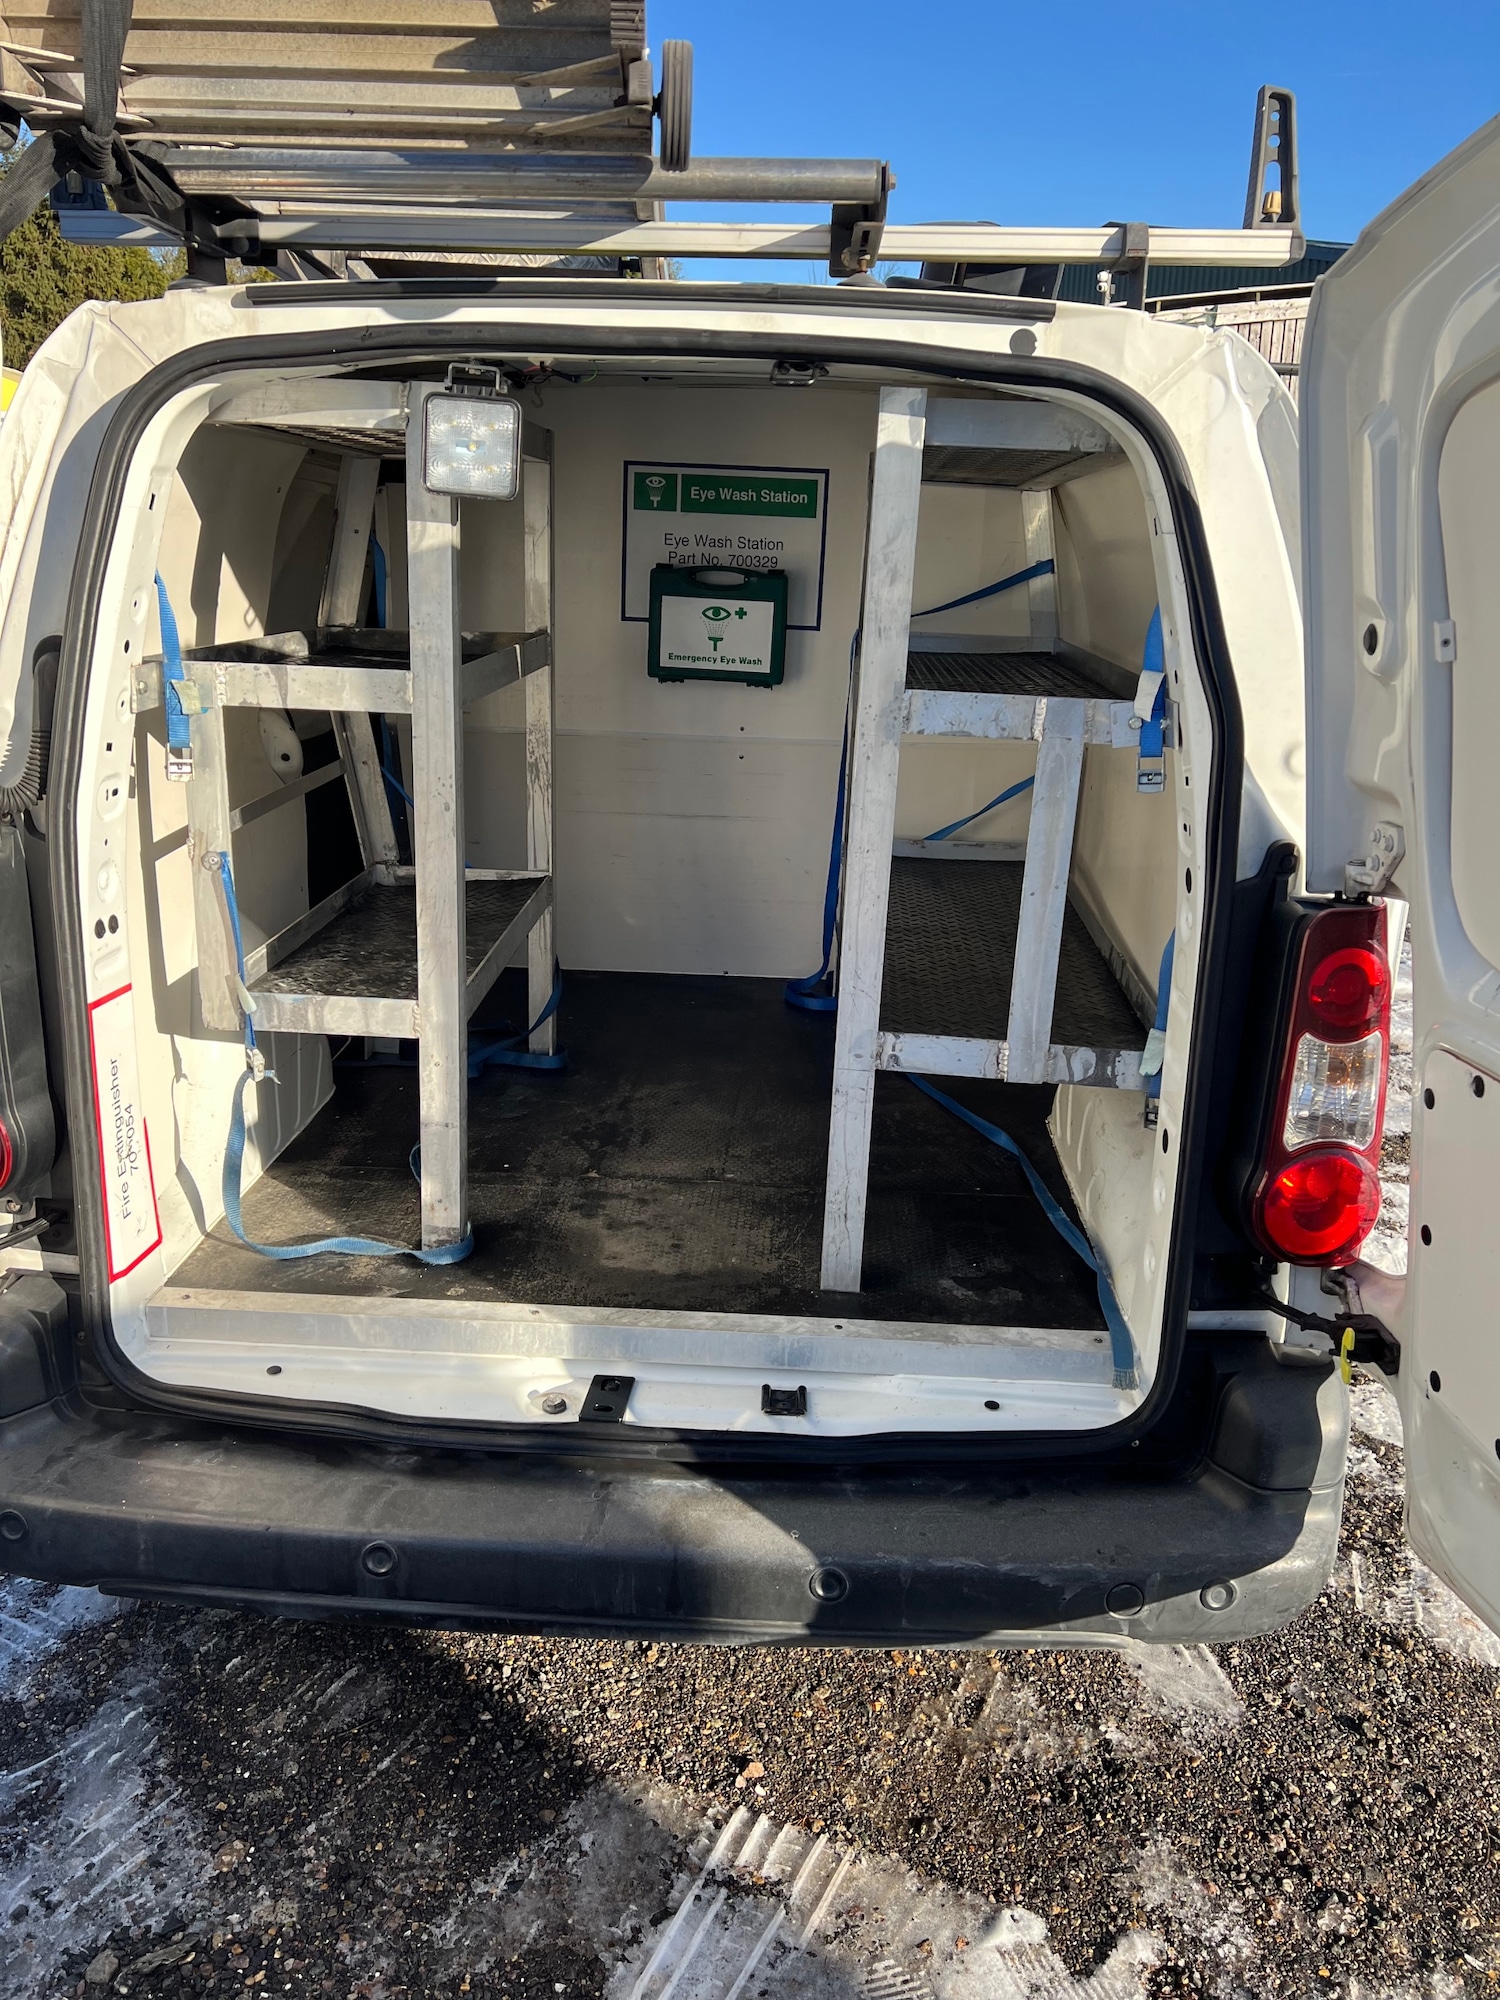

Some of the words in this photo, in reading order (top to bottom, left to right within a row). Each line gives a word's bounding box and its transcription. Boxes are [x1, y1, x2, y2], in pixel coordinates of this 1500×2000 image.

[691, 486, 716, 502] Eye
[719, 488, 756, 502] Wash
[760, 489, 808, 504] Station
[664, 532, 690, 550] Eye
[694, 534, 732, 549] Wash
[737, 536, 784, 551] Station
[668, 551, 696, 565] Part
[700, 552, 723, 566] No.
[728, 554, 778, 568] 700329
[668, 652, 717, 664] Emergency
[720, 656, 736, 665] Eye
[739, 656, 762, 666] Wash
[121, 1180, 132, 1220] Fire
